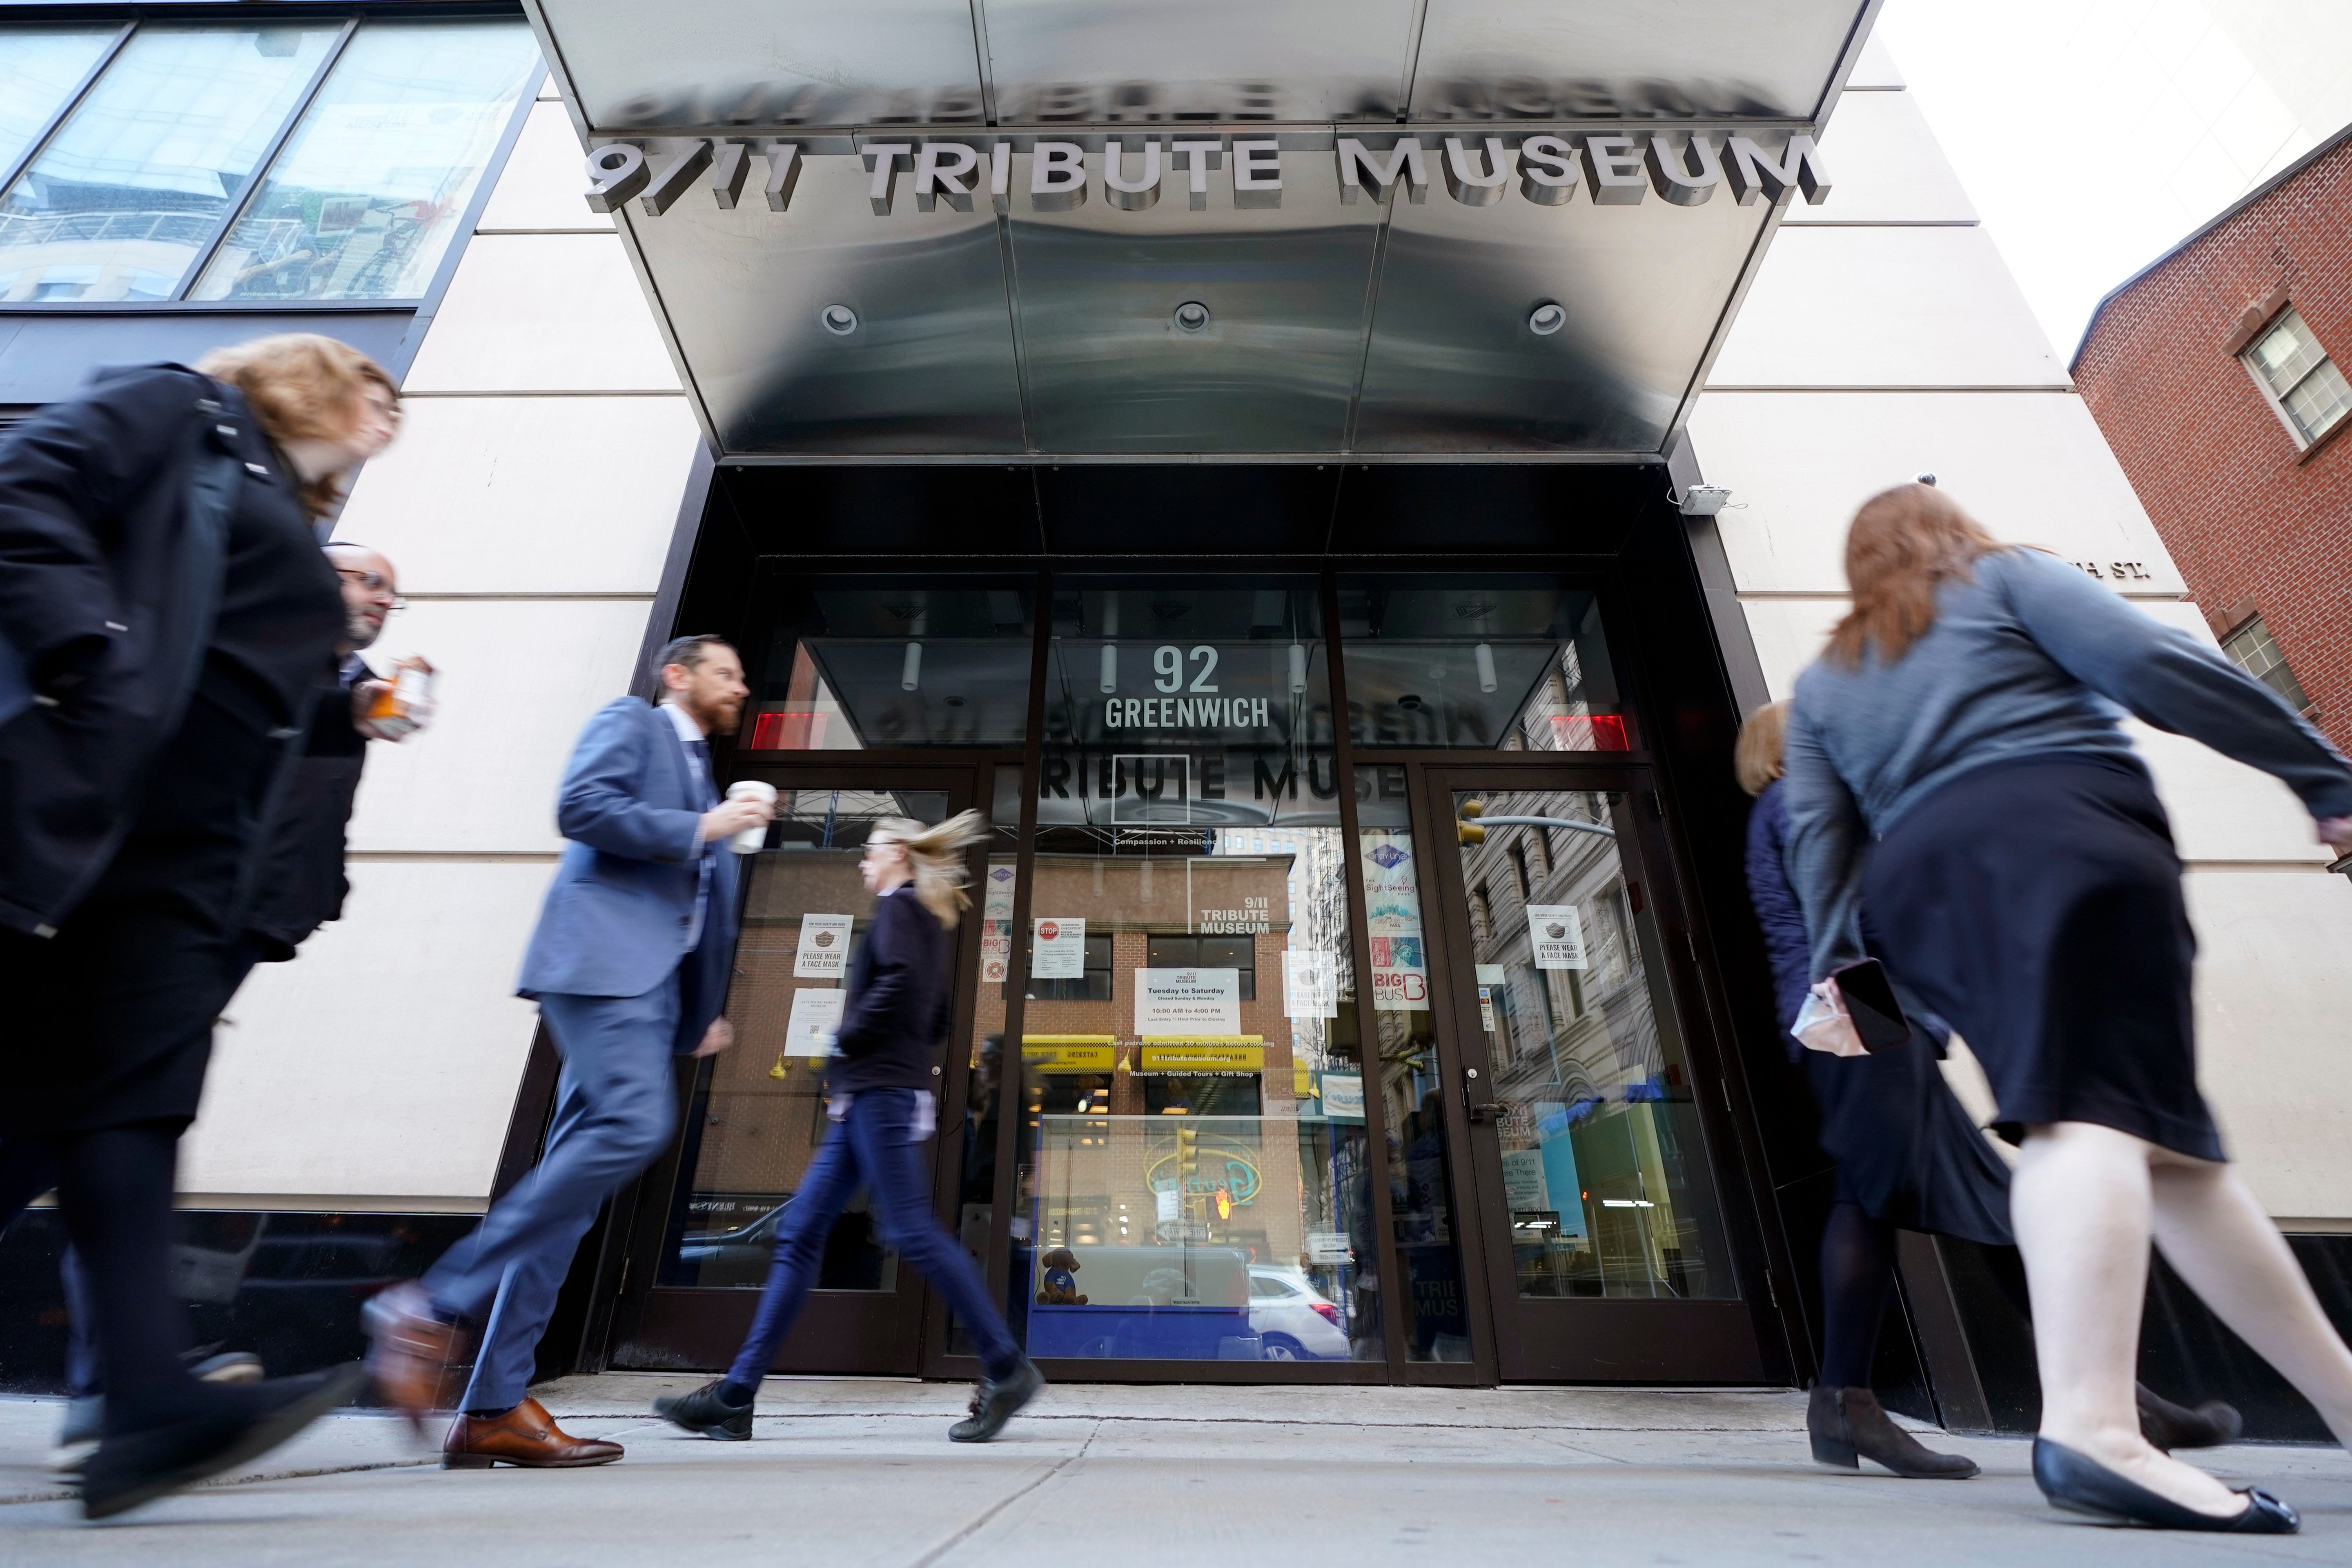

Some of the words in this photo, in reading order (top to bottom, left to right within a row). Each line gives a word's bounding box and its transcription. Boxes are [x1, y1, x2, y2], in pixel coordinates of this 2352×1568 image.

[584, 142, 803, 214] 9/11
[861, 140, 1281, 215] TRIBUTE
[1336, 135, 1833, 207] MUSEUM
[2110, 561, 2150, 578] ST.
[1153, 644, 1219, 694] 92
[1105, 697, 1269, 728] GREENWICH
[1366, 884, 1415, 893] SightSeeing
[1201, 910, 1269, 921] TRIBUTE
[1200, 922, 1269, 934] MUSEUM
[1374, 973, 1401, 987] BIG
[1375, 988, 1403, 1000] BUS
